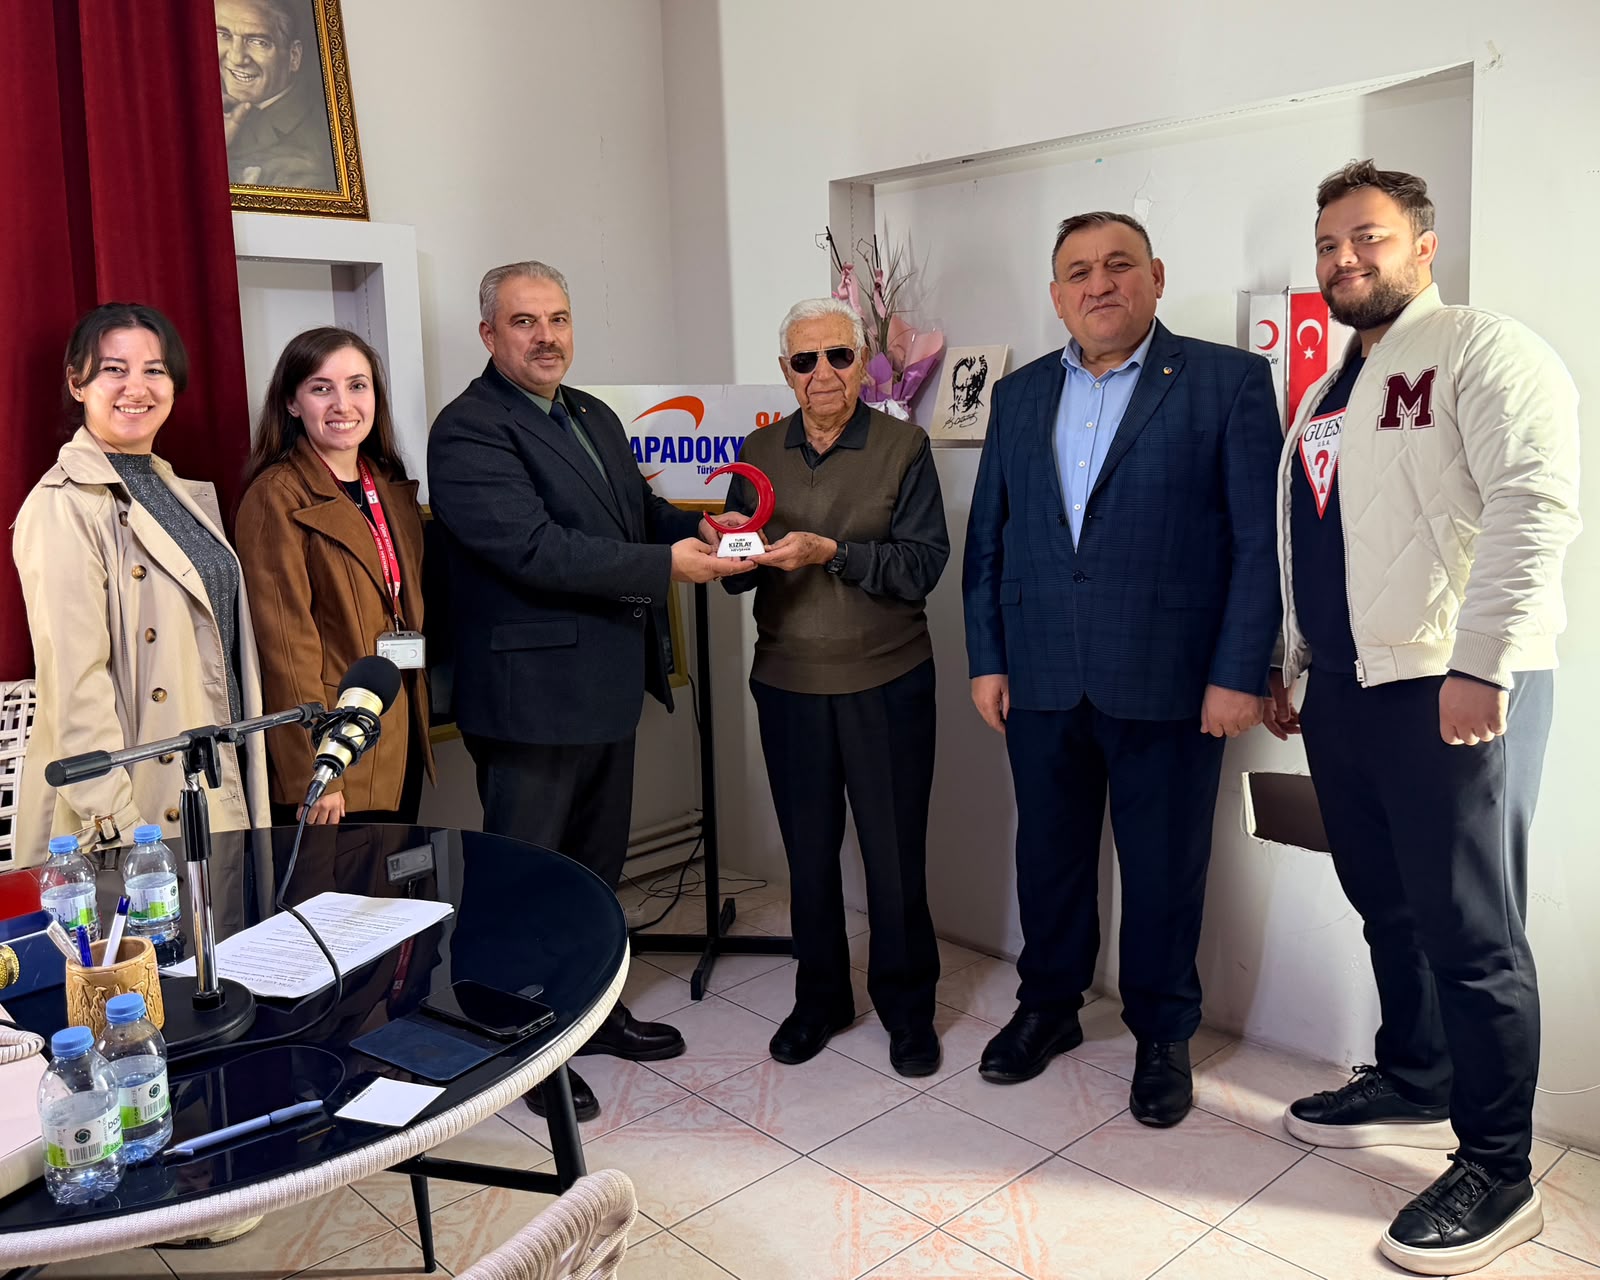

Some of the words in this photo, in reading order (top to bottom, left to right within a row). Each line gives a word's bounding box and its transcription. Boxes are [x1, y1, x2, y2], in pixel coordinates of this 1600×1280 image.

[1376, 365, 1438, 431] M
[630, 437, 745, 463] APADOKY
[728, 541, 752, 549] KIZILAY
